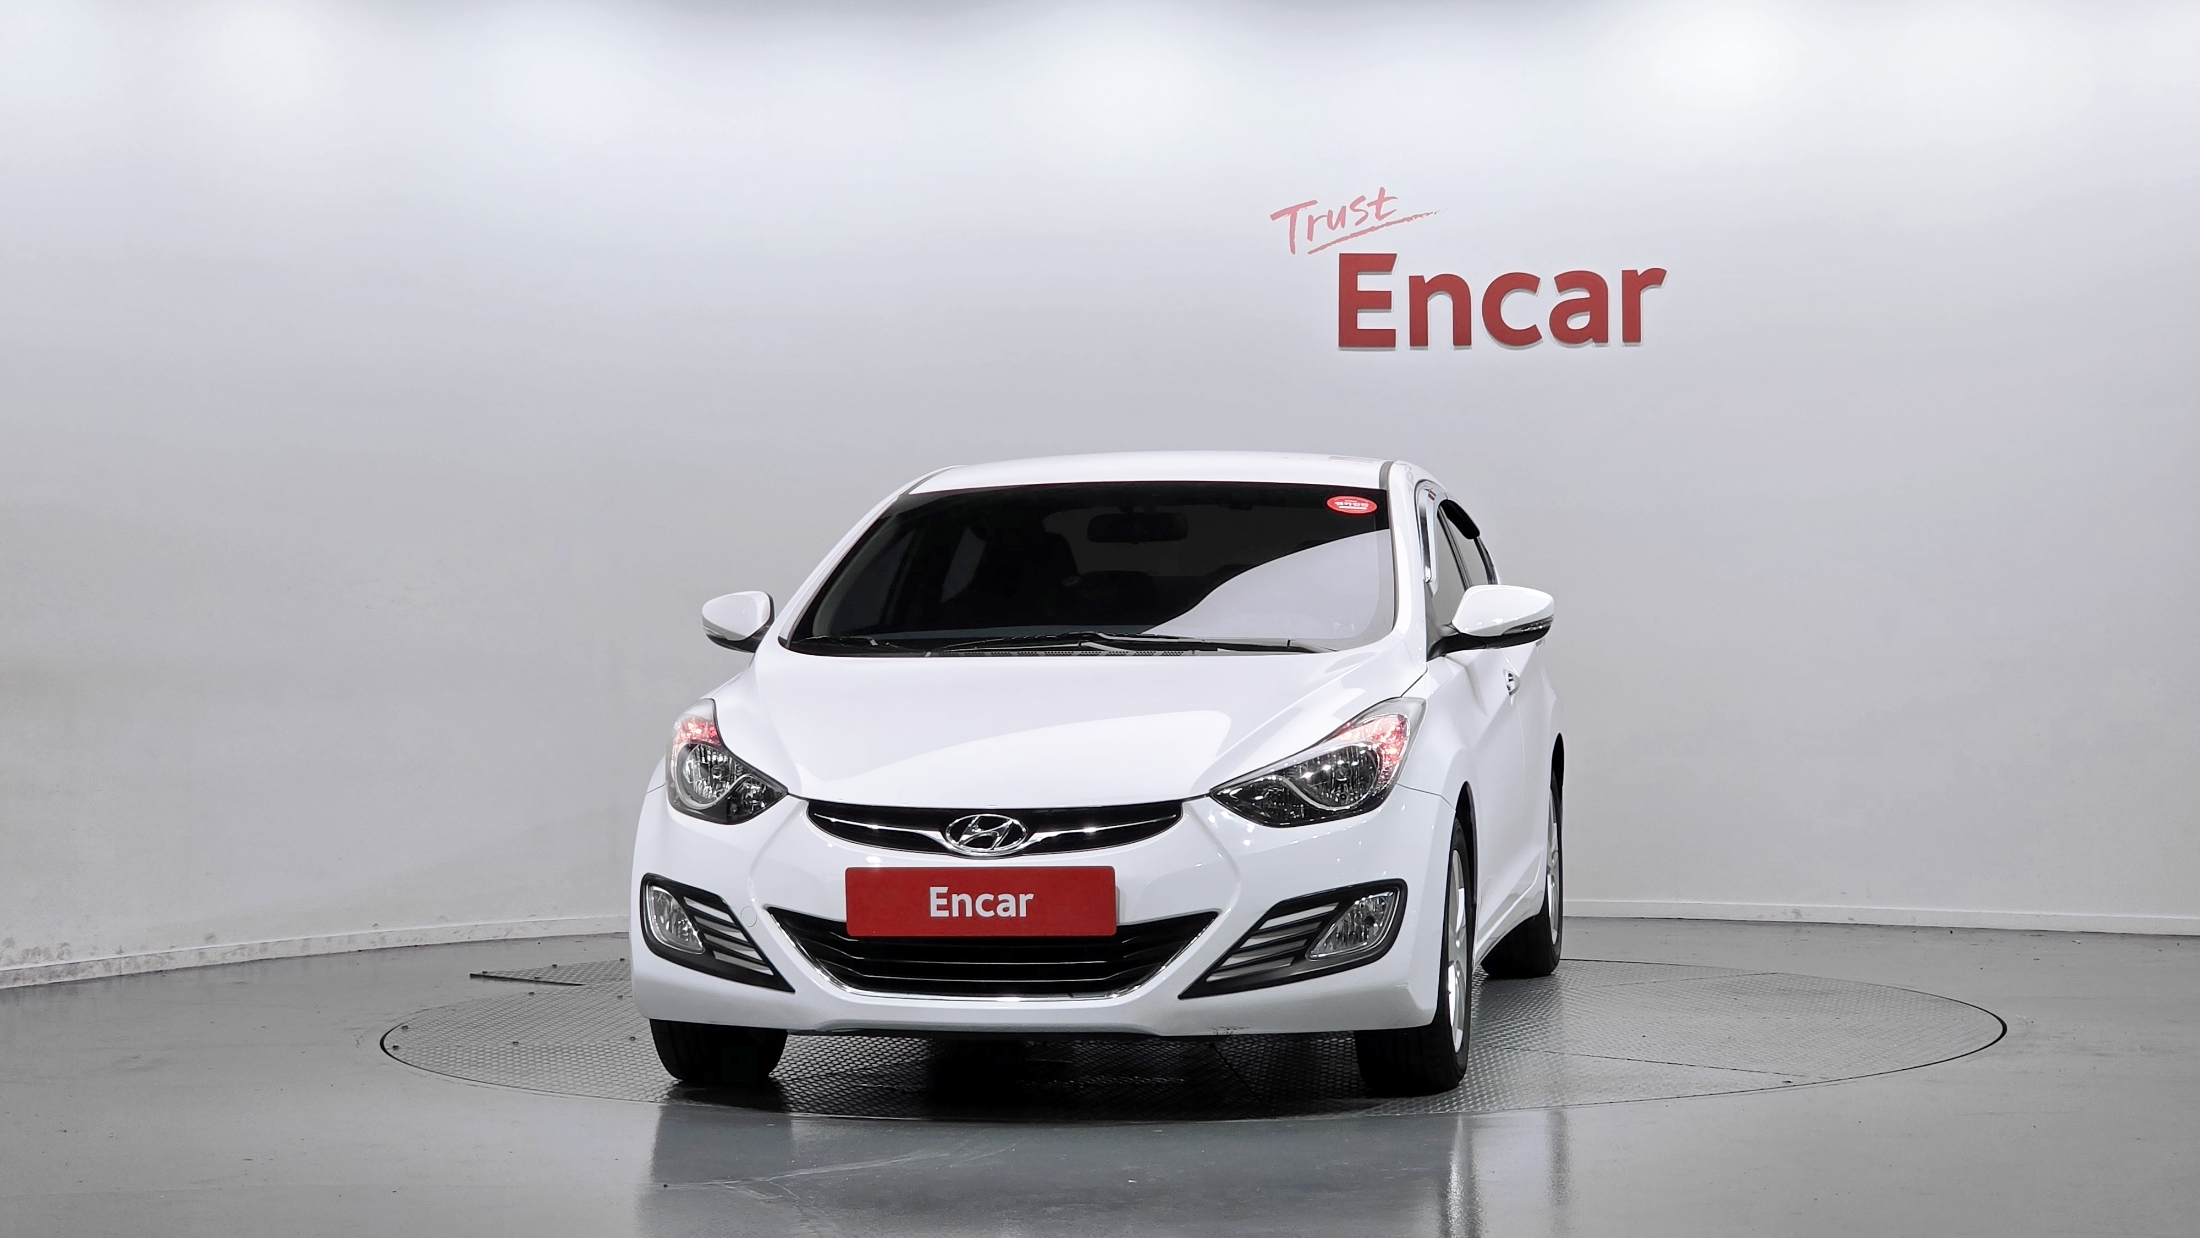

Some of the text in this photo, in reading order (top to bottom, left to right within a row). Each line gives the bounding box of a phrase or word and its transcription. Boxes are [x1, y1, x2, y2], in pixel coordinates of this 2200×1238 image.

[1270, 186, 1399, 255] Trust
[1338, 252, 1668, 349] Encar
[929, 886, 1035, 919] Encar
